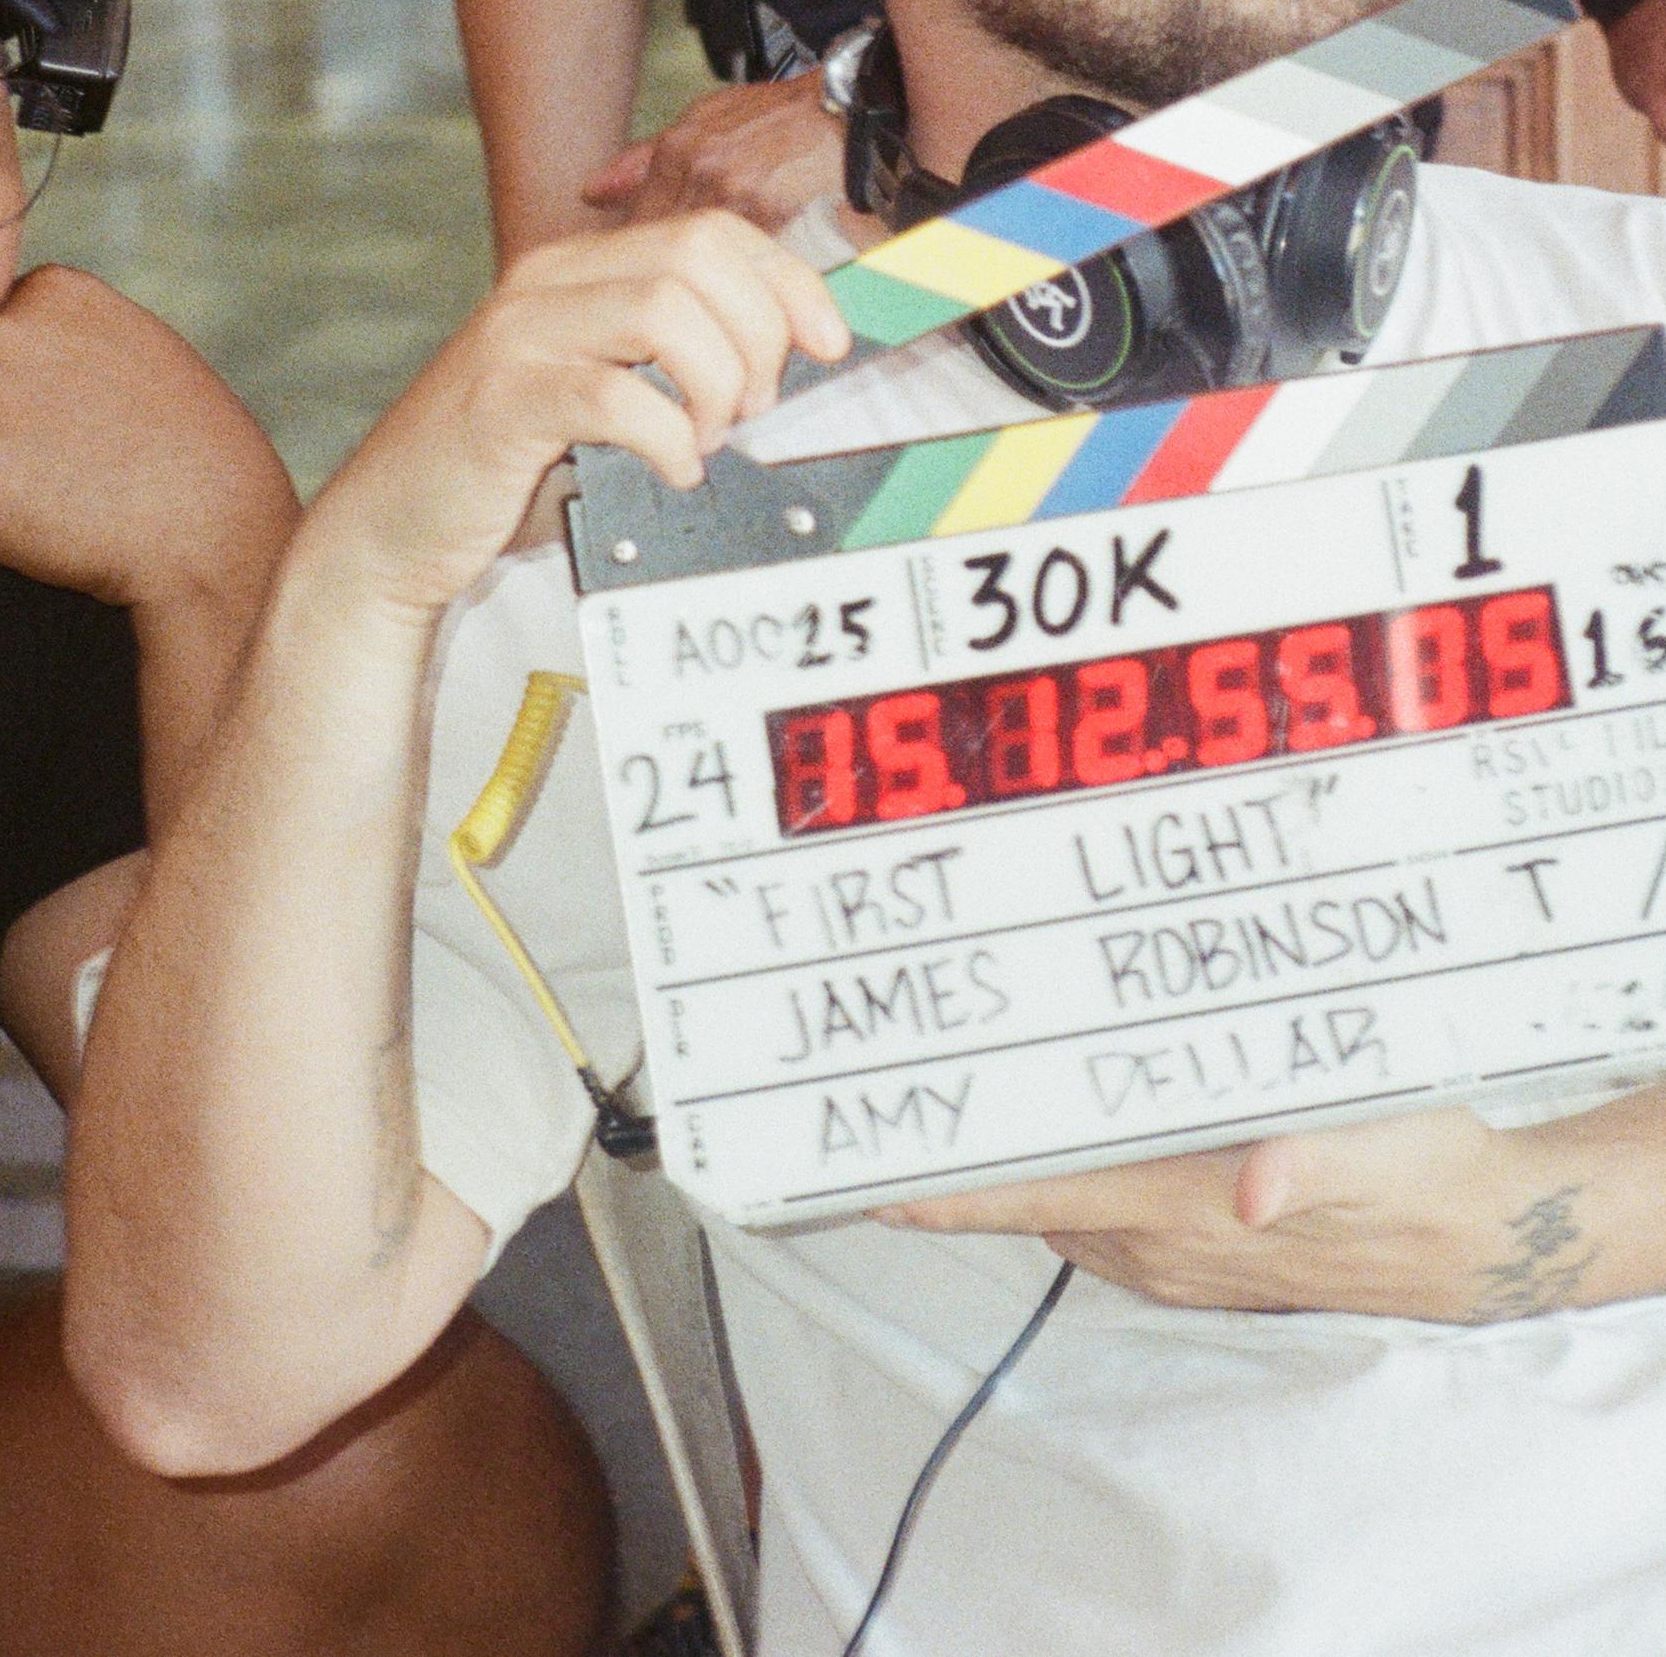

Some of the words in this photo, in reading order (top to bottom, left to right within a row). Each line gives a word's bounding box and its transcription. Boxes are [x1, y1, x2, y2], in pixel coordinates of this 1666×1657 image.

[1452, 463, 1504, 580] 1
[962, 528, 1180, 652] 30K
[619, 740, 736, 835] 24
[778, 948, 1011, 1063] JAMES
[1095, 876, 1449, 1009] ROBINSON
[819, 1073, 975, 1166] AMY
